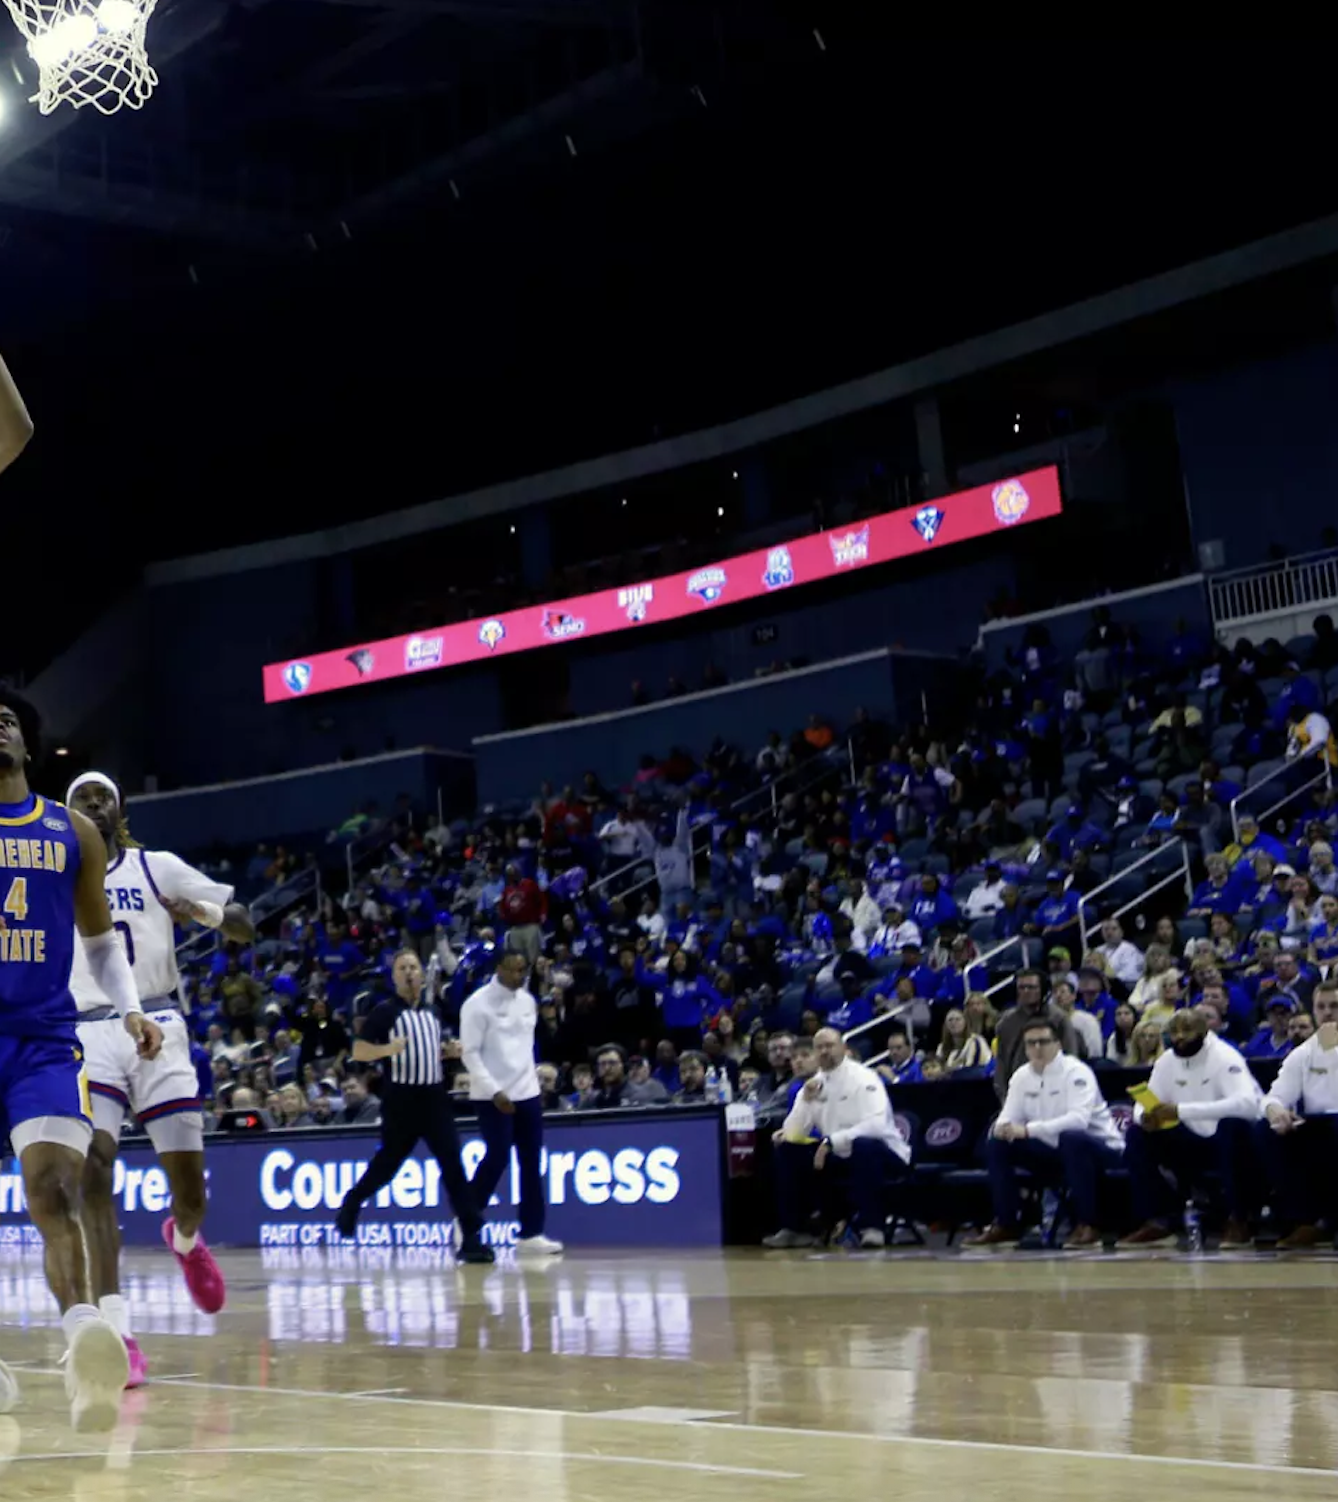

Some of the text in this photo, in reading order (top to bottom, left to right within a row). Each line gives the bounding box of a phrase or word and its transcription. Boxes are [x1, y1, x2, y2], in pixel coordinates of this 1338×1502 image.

[3, 877, 28, 921] 4
[260, 1223, 298, 1245] PART
[300, 1223, 324, 1245] OF
[357, 1223, 392, 1245] USA
[394, 1223, 453, 1245] TODAY
